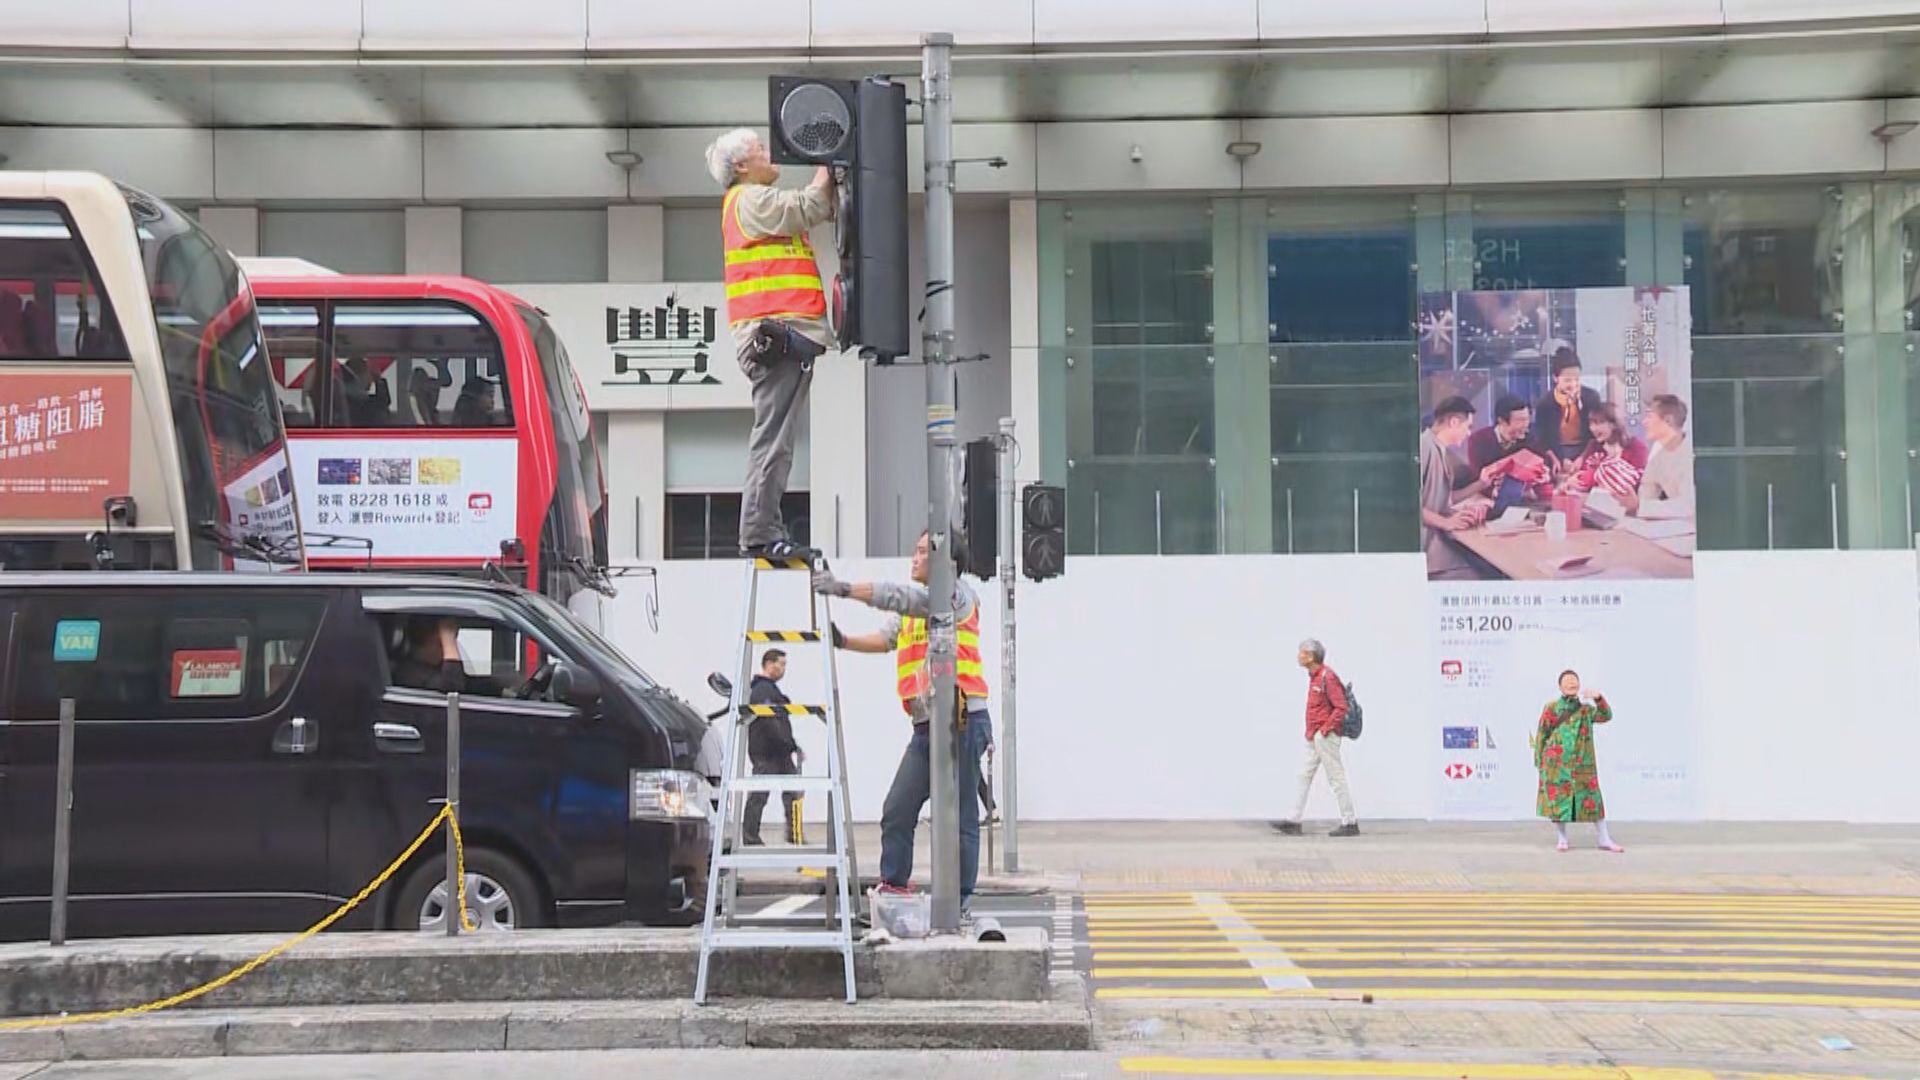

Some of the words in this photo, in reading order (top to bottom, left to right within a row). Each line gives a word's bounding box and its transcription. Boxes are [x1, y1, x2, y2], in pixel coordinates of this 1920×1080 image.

[601, 305, 722, 385] 豐
[318, 494, 343, 507] 致電
[349, 494, 388, 506] 8228
[395, 494, 431, 506] 1618
[436, 494, 449, 506] 或
[318, 511, 343, 524] 登入
[1456, 616, 1513, 633] $1,200
[61, 635, 95, 650] VAN
